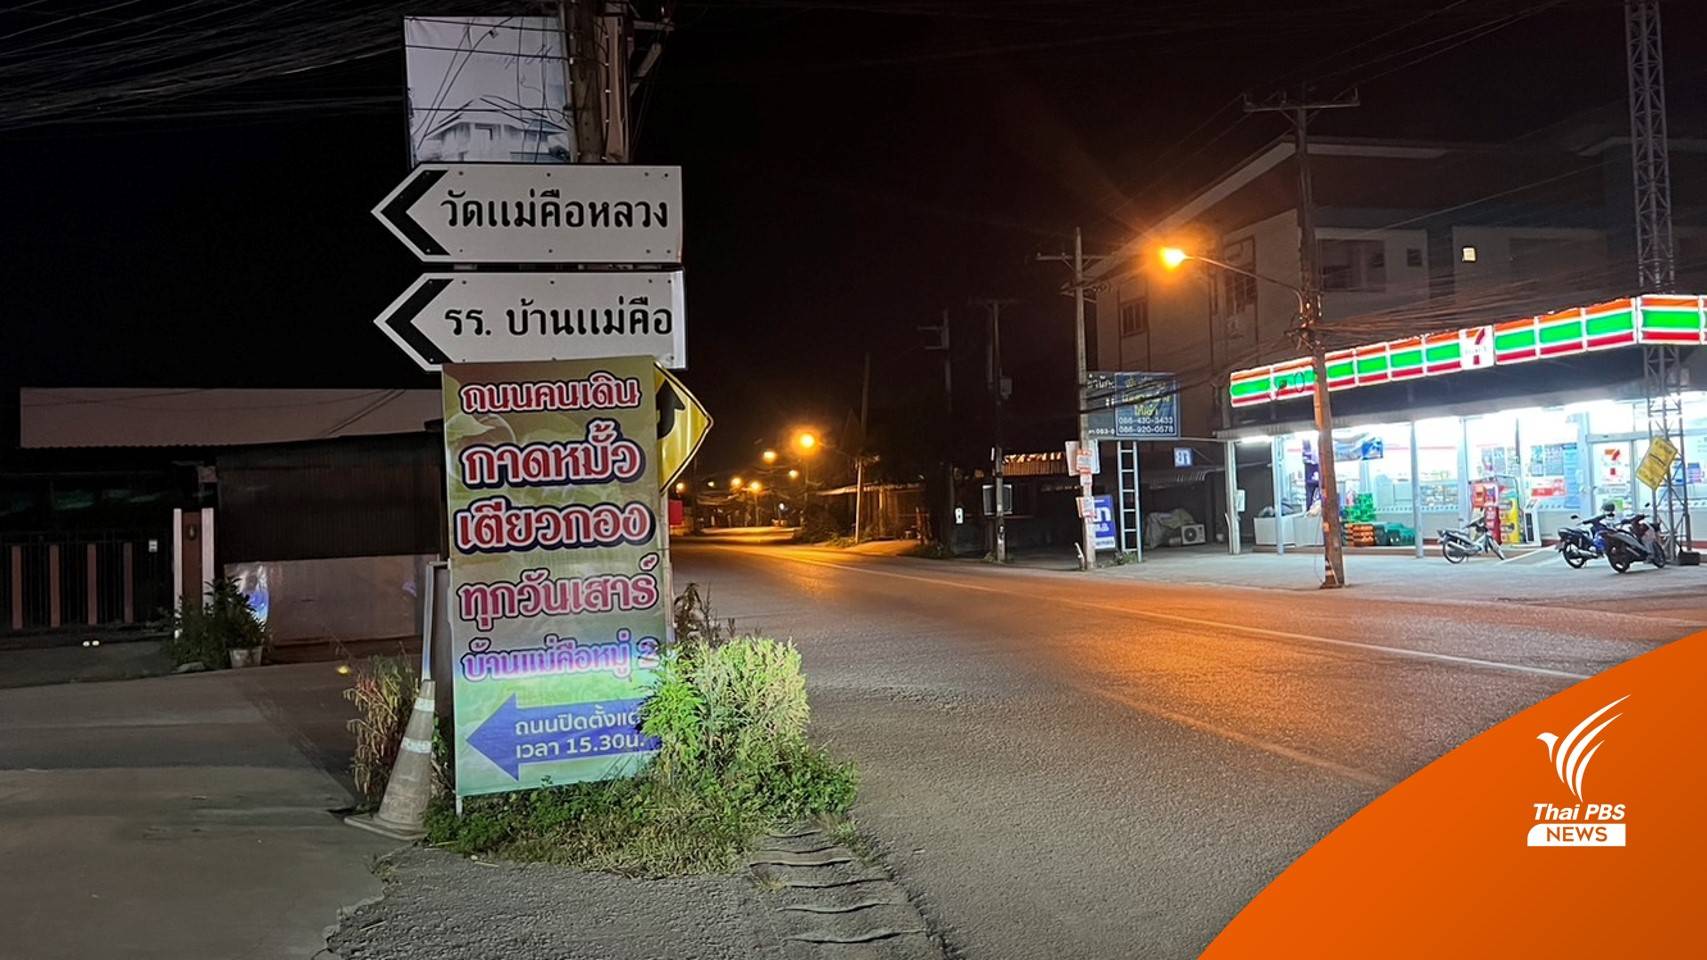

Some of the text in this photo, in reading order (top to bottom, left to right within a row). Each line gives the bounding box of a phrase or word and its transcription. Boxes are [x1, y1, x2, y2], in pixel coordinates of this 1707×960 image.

[440, 188, 668, 228] วัดแม่คือหลวง
[444, 297, 672, 336] รร. บ้านแม่คือ
[461, 373, 640, 412] ถนนคนเดิน
[462, 420, 643, 485] กาดหมั้ว
[456, 498, 652, 550] เตียวกอง
[458, 556, 658, 631] ทุกวันเสาร์
[463, 630, 631, 680] บ้านแม่คือหมู่
[515, 704, 641, 736] ถนนปิดตั้งแต
[515, 733, 645, 759] เวลา 15.30น.
